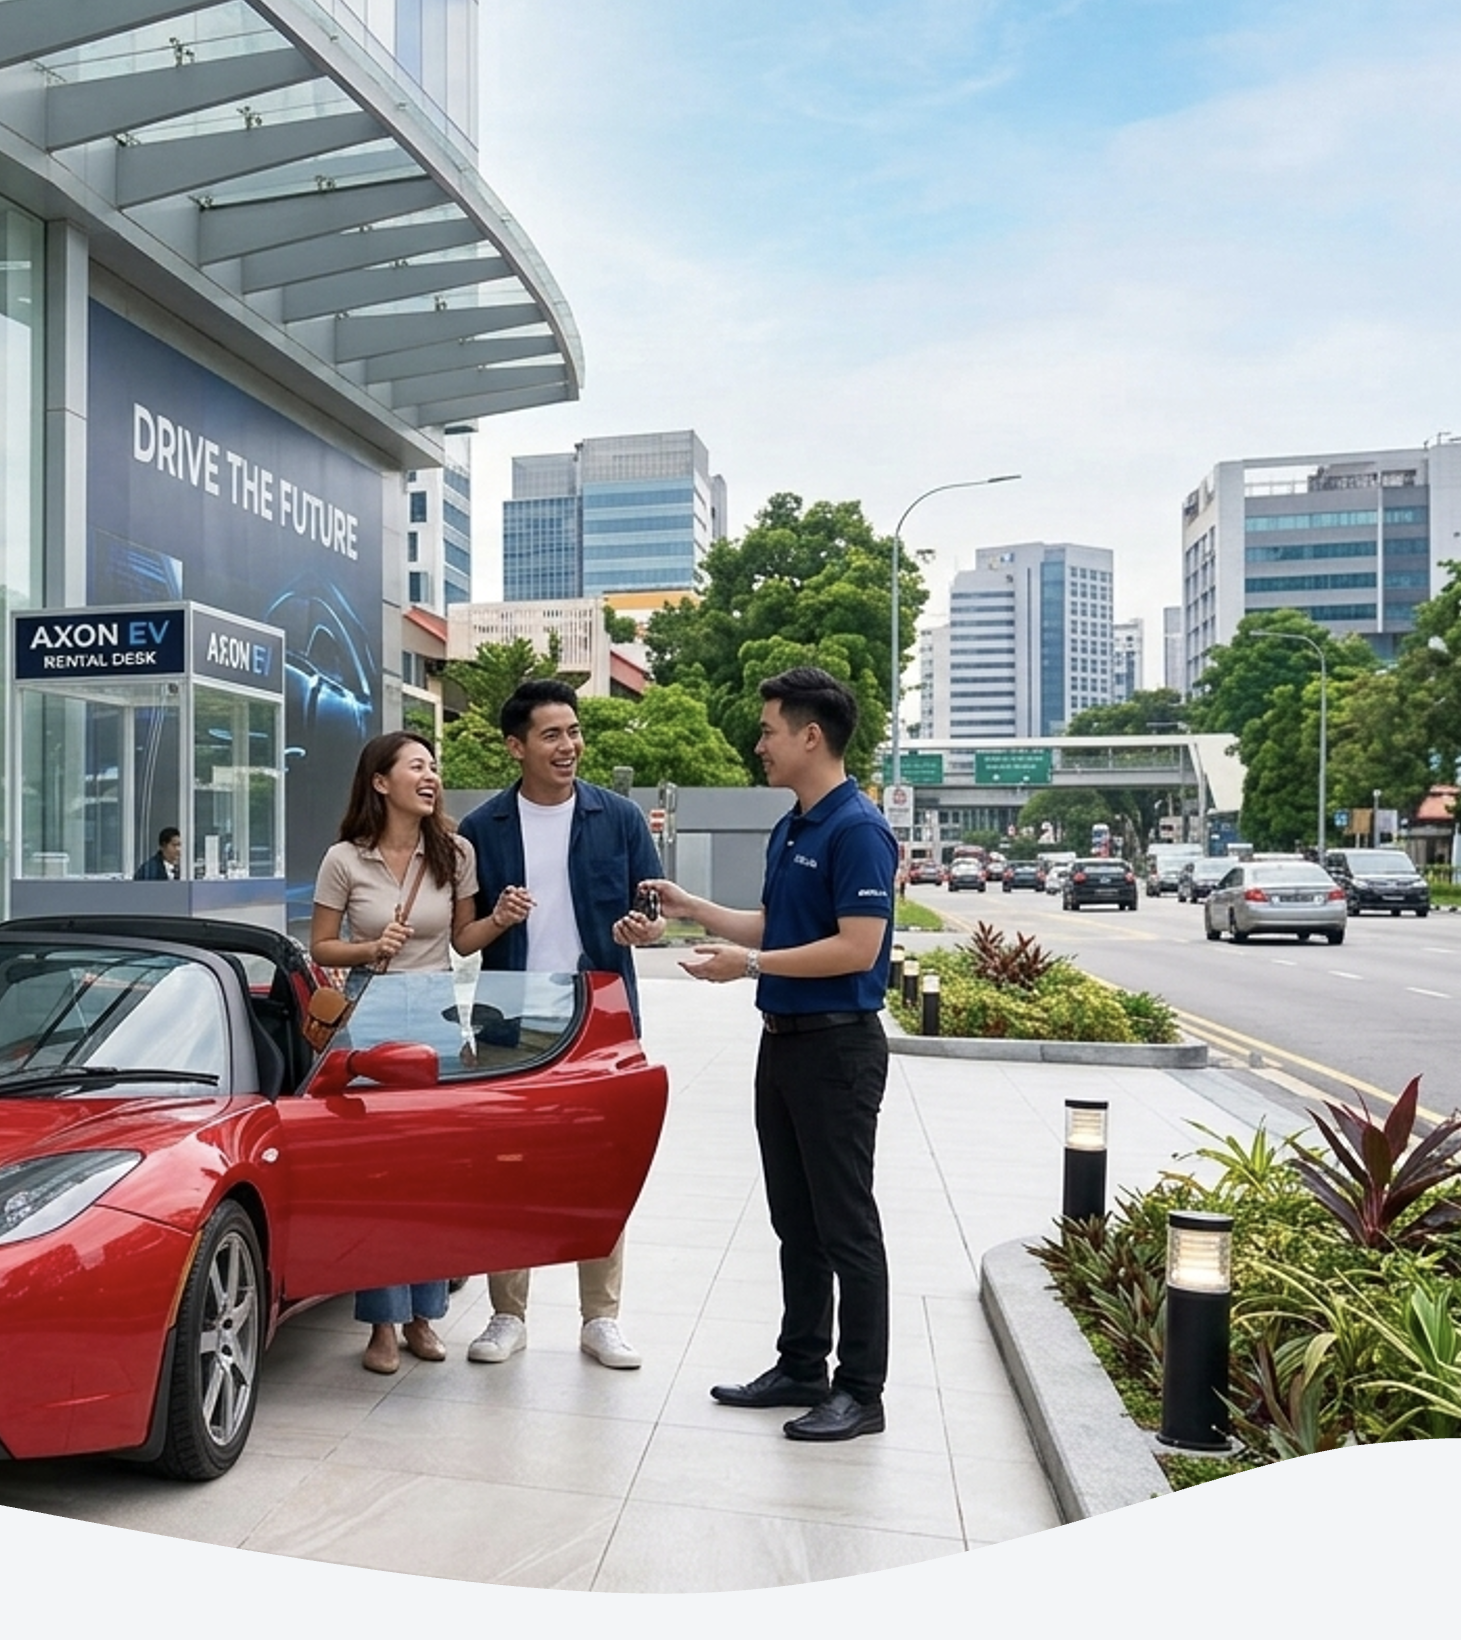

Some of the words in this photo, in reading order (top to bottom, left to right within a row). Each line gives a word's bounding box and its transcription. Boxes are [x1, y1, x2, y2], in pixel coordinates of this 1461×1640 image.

[133, 402, 220, 496] DRIVE
[226, 450, 273, 521] THE
[280, 478, 358, 561] FUTURE
[30, 623, 119, 649] AXON
[128, 619, 170, 646] EV
[43, 653, 108, 669] RENTAL
[112, 651, 157, 666] DESK
